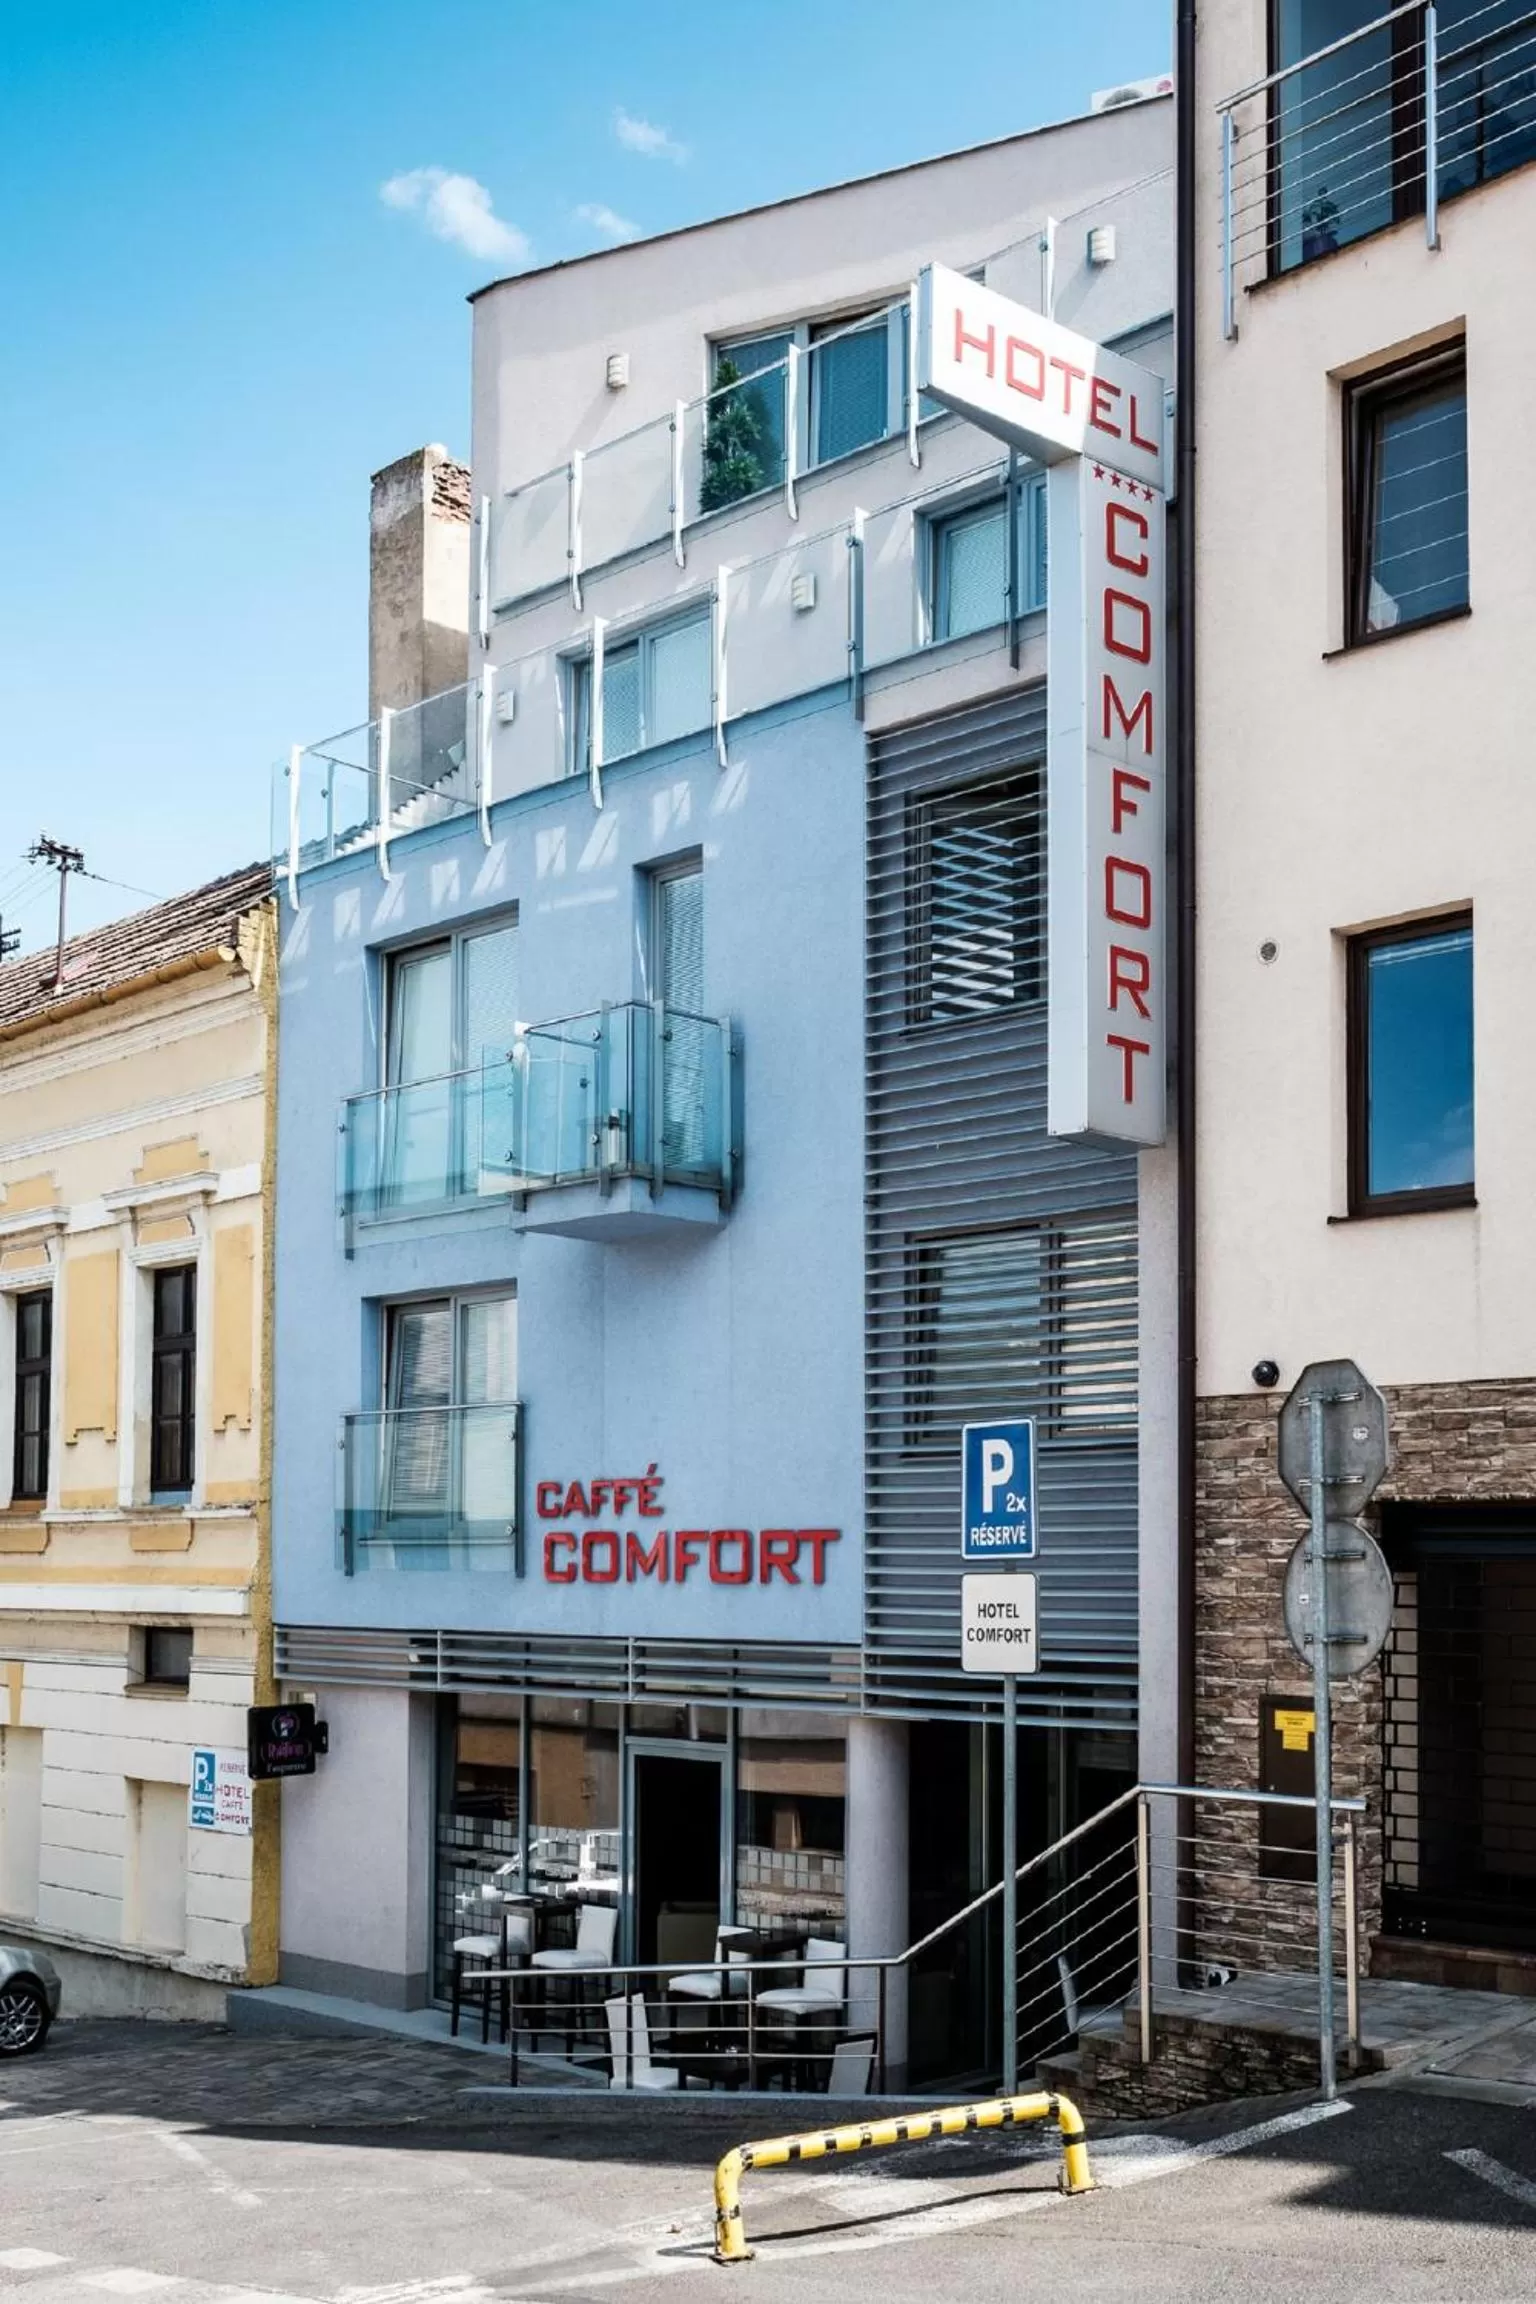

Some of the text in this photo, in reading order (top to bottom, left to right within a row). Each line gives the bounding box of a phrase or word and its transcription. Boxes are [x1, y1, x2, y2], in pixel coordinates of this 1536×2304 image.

[953, 307, 1159, 456] HOTEL
[1102, 501, 1154, 1105] COMFORT
[536, 1463, 665, 1519] CAFFÉ
[982, 1438, 1027, 1513] P 2x
[543, 1528, 842, 1586] COMFORT
[966, 1626, 1032, 1645] COMFORT
[976, 1602, 1020, 1619] HOTEL
[216, 1783, 251, 1800] HOTEL
